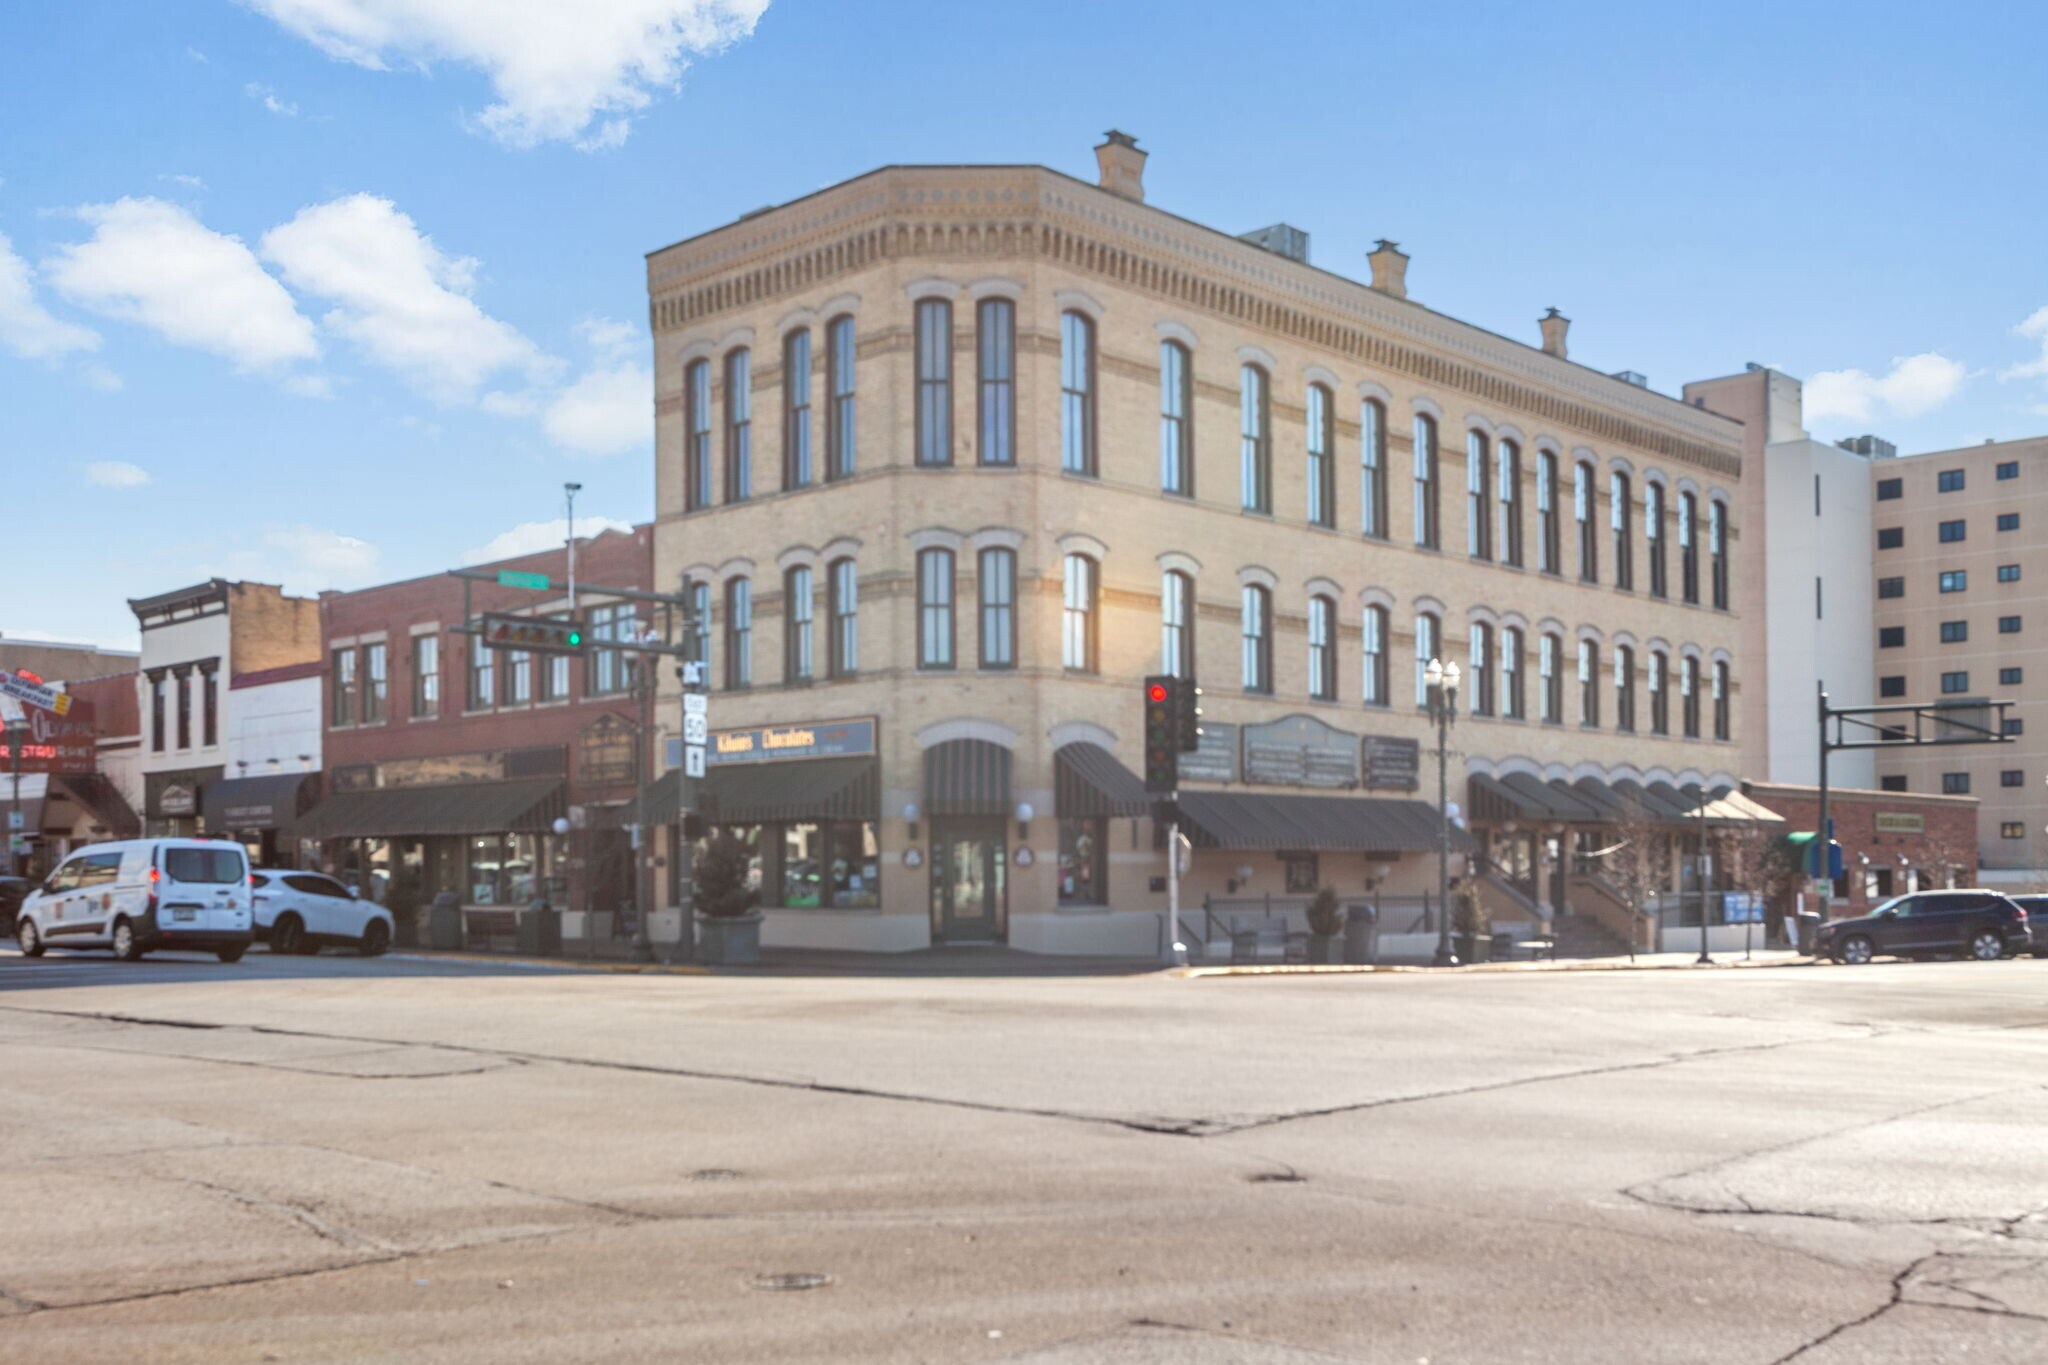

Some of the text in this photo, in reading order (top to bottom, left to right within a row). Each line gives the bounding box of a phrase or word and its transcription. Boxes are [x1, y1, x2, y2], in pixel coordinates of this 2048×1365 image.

[687, 717, 706, 738] 50
[762, 729, 815, 749] Chocolates
[0, 744, 95, 759] RSTAURANT
